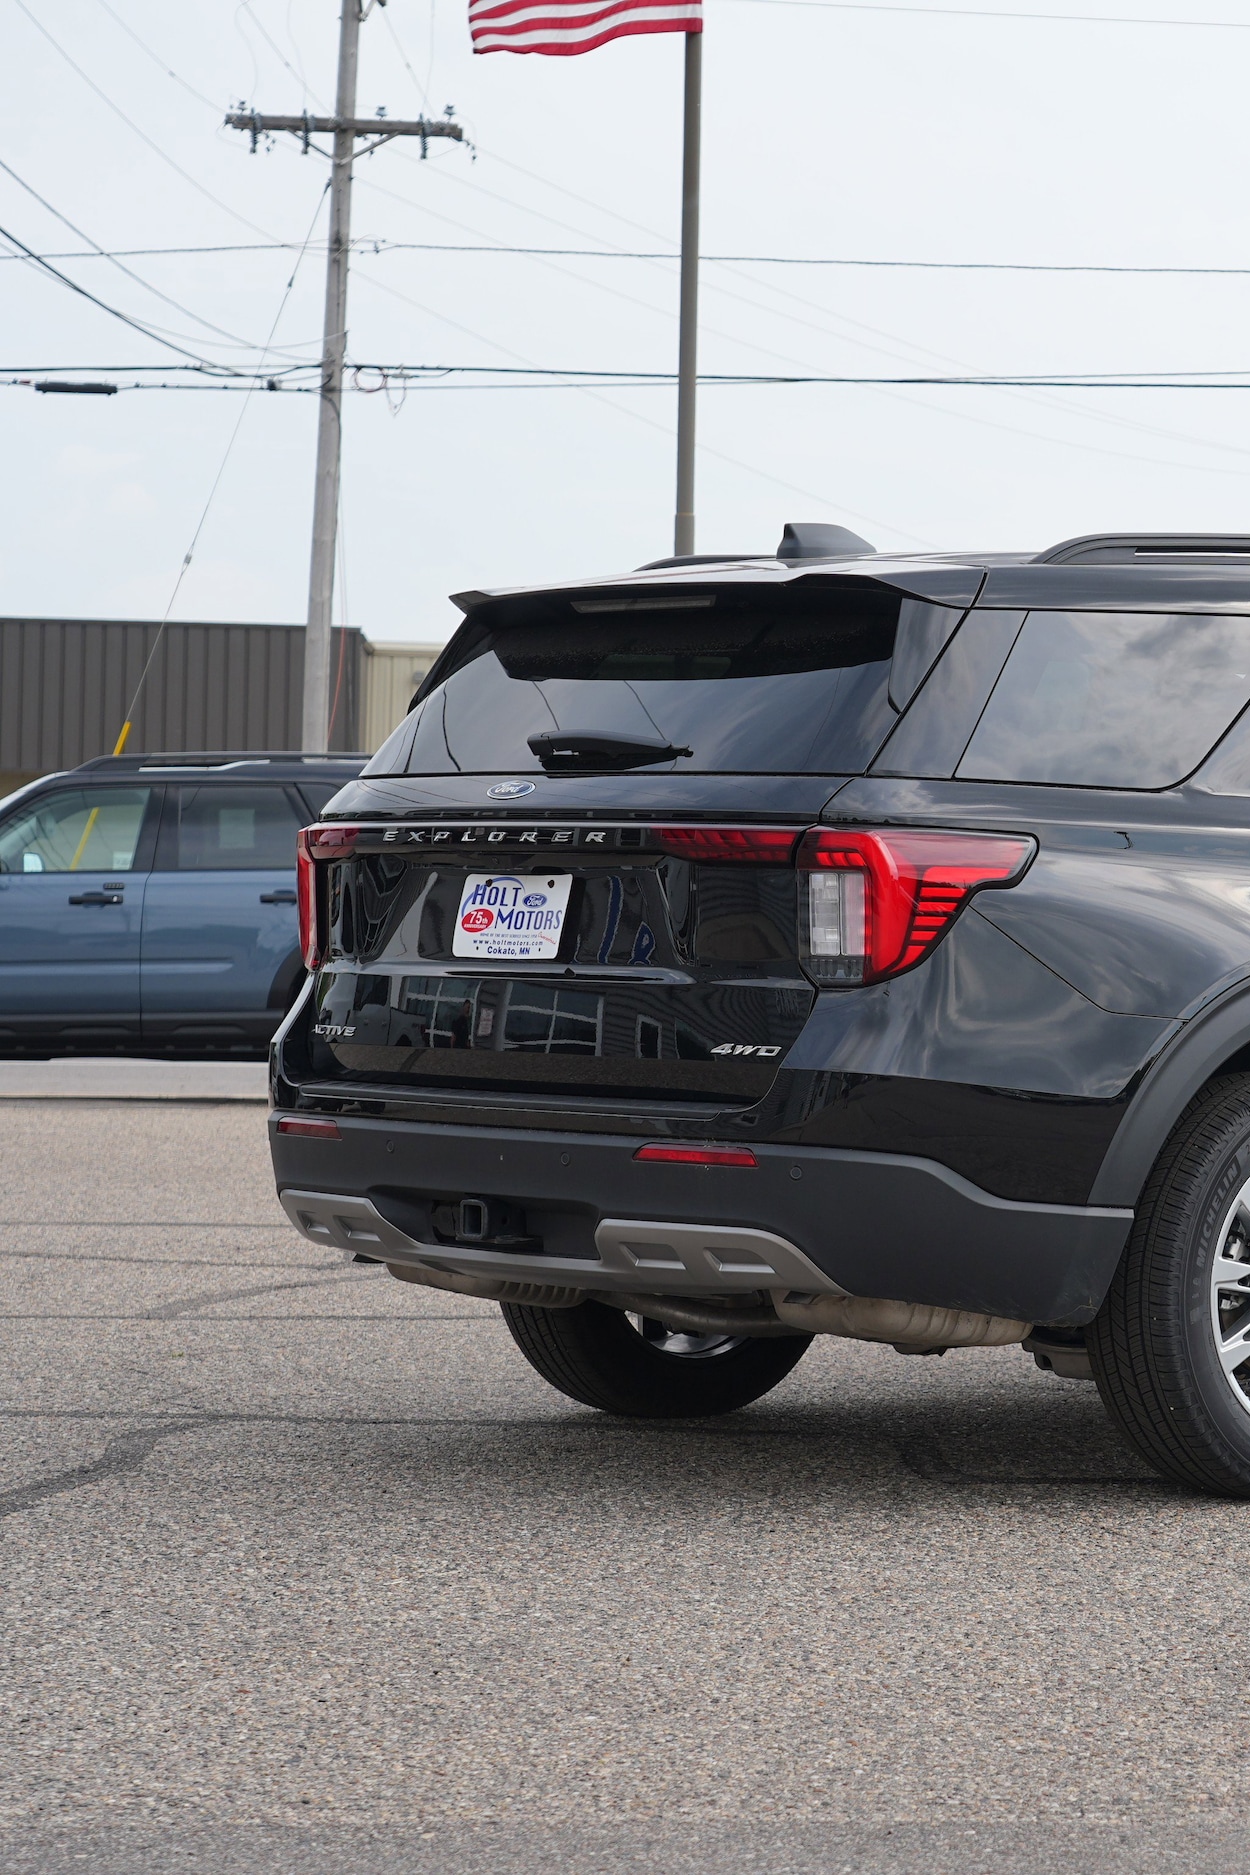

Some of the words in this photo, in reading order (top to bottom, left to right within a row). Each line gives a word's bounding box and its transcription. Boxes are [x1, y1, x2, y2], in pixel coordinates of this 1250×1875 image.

[493, 780, 527, 796] Ford
[382, 831, 606, 843] EXPLORER
[471, 884, 522, 907] HOLT
[525, 894, 545, 908] Ford
[469, 911, 488, 925] 75th
[494, 908, 563, 931] MOTORS
[487, 946, 517, 956] Cokato,
[519, 947, 531, 955] MN
[311, 1024, 357, 1037] ACTIVE
[710, 1043, 782, 1057] 4WD
[1195, 1162, 1239, 1269] MICHELIN
